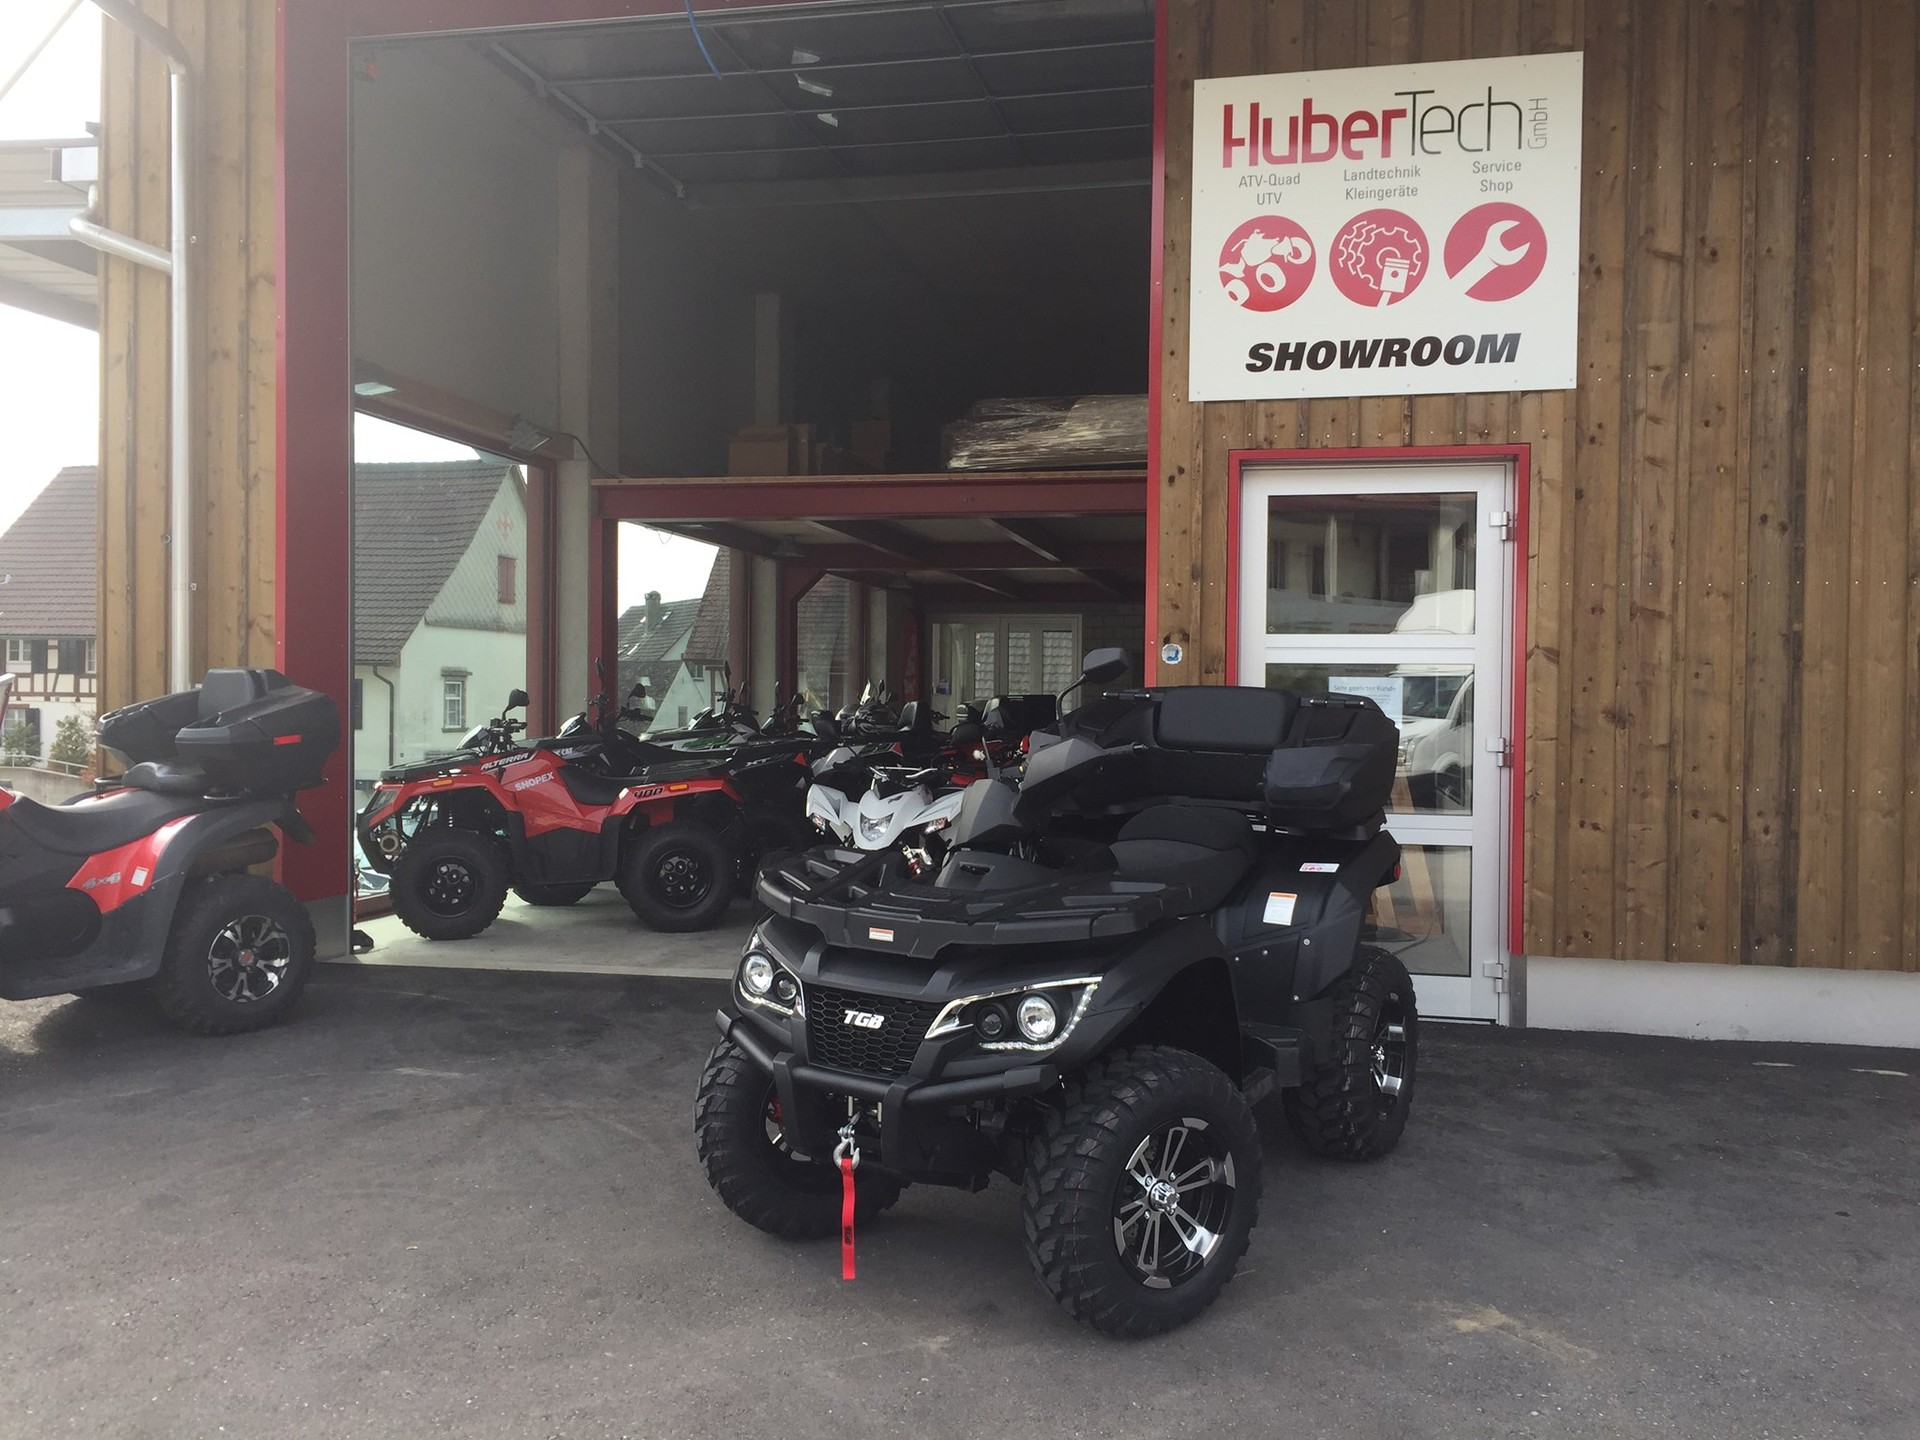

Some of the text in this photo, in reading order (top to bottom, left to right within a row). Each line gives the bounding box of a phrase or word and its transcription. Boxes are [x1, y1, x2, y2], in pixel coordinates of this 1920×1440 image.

[1222, 86, 1548, 169] HuberTech GmbH
[1343, 165, 1422, 182] Landtechnik
[1472, 160, 1522, 174] Service
[1238, 172, 1301, 188] ATV-Quad
[1479, 179, 1514, 194] Shop
[1256, 193, 1283, 206] UTV
[1344, 185, 1419, 202] Kleingeräte
[1245, 333, 1522, 373] SHOWROOM
[480, 752, 530, 771] ALTERRA
[514, 771, 555, 792] SNOPEX
[633, 787, 664, 799] 400
[843, 1009, 885, 1029] TGB
